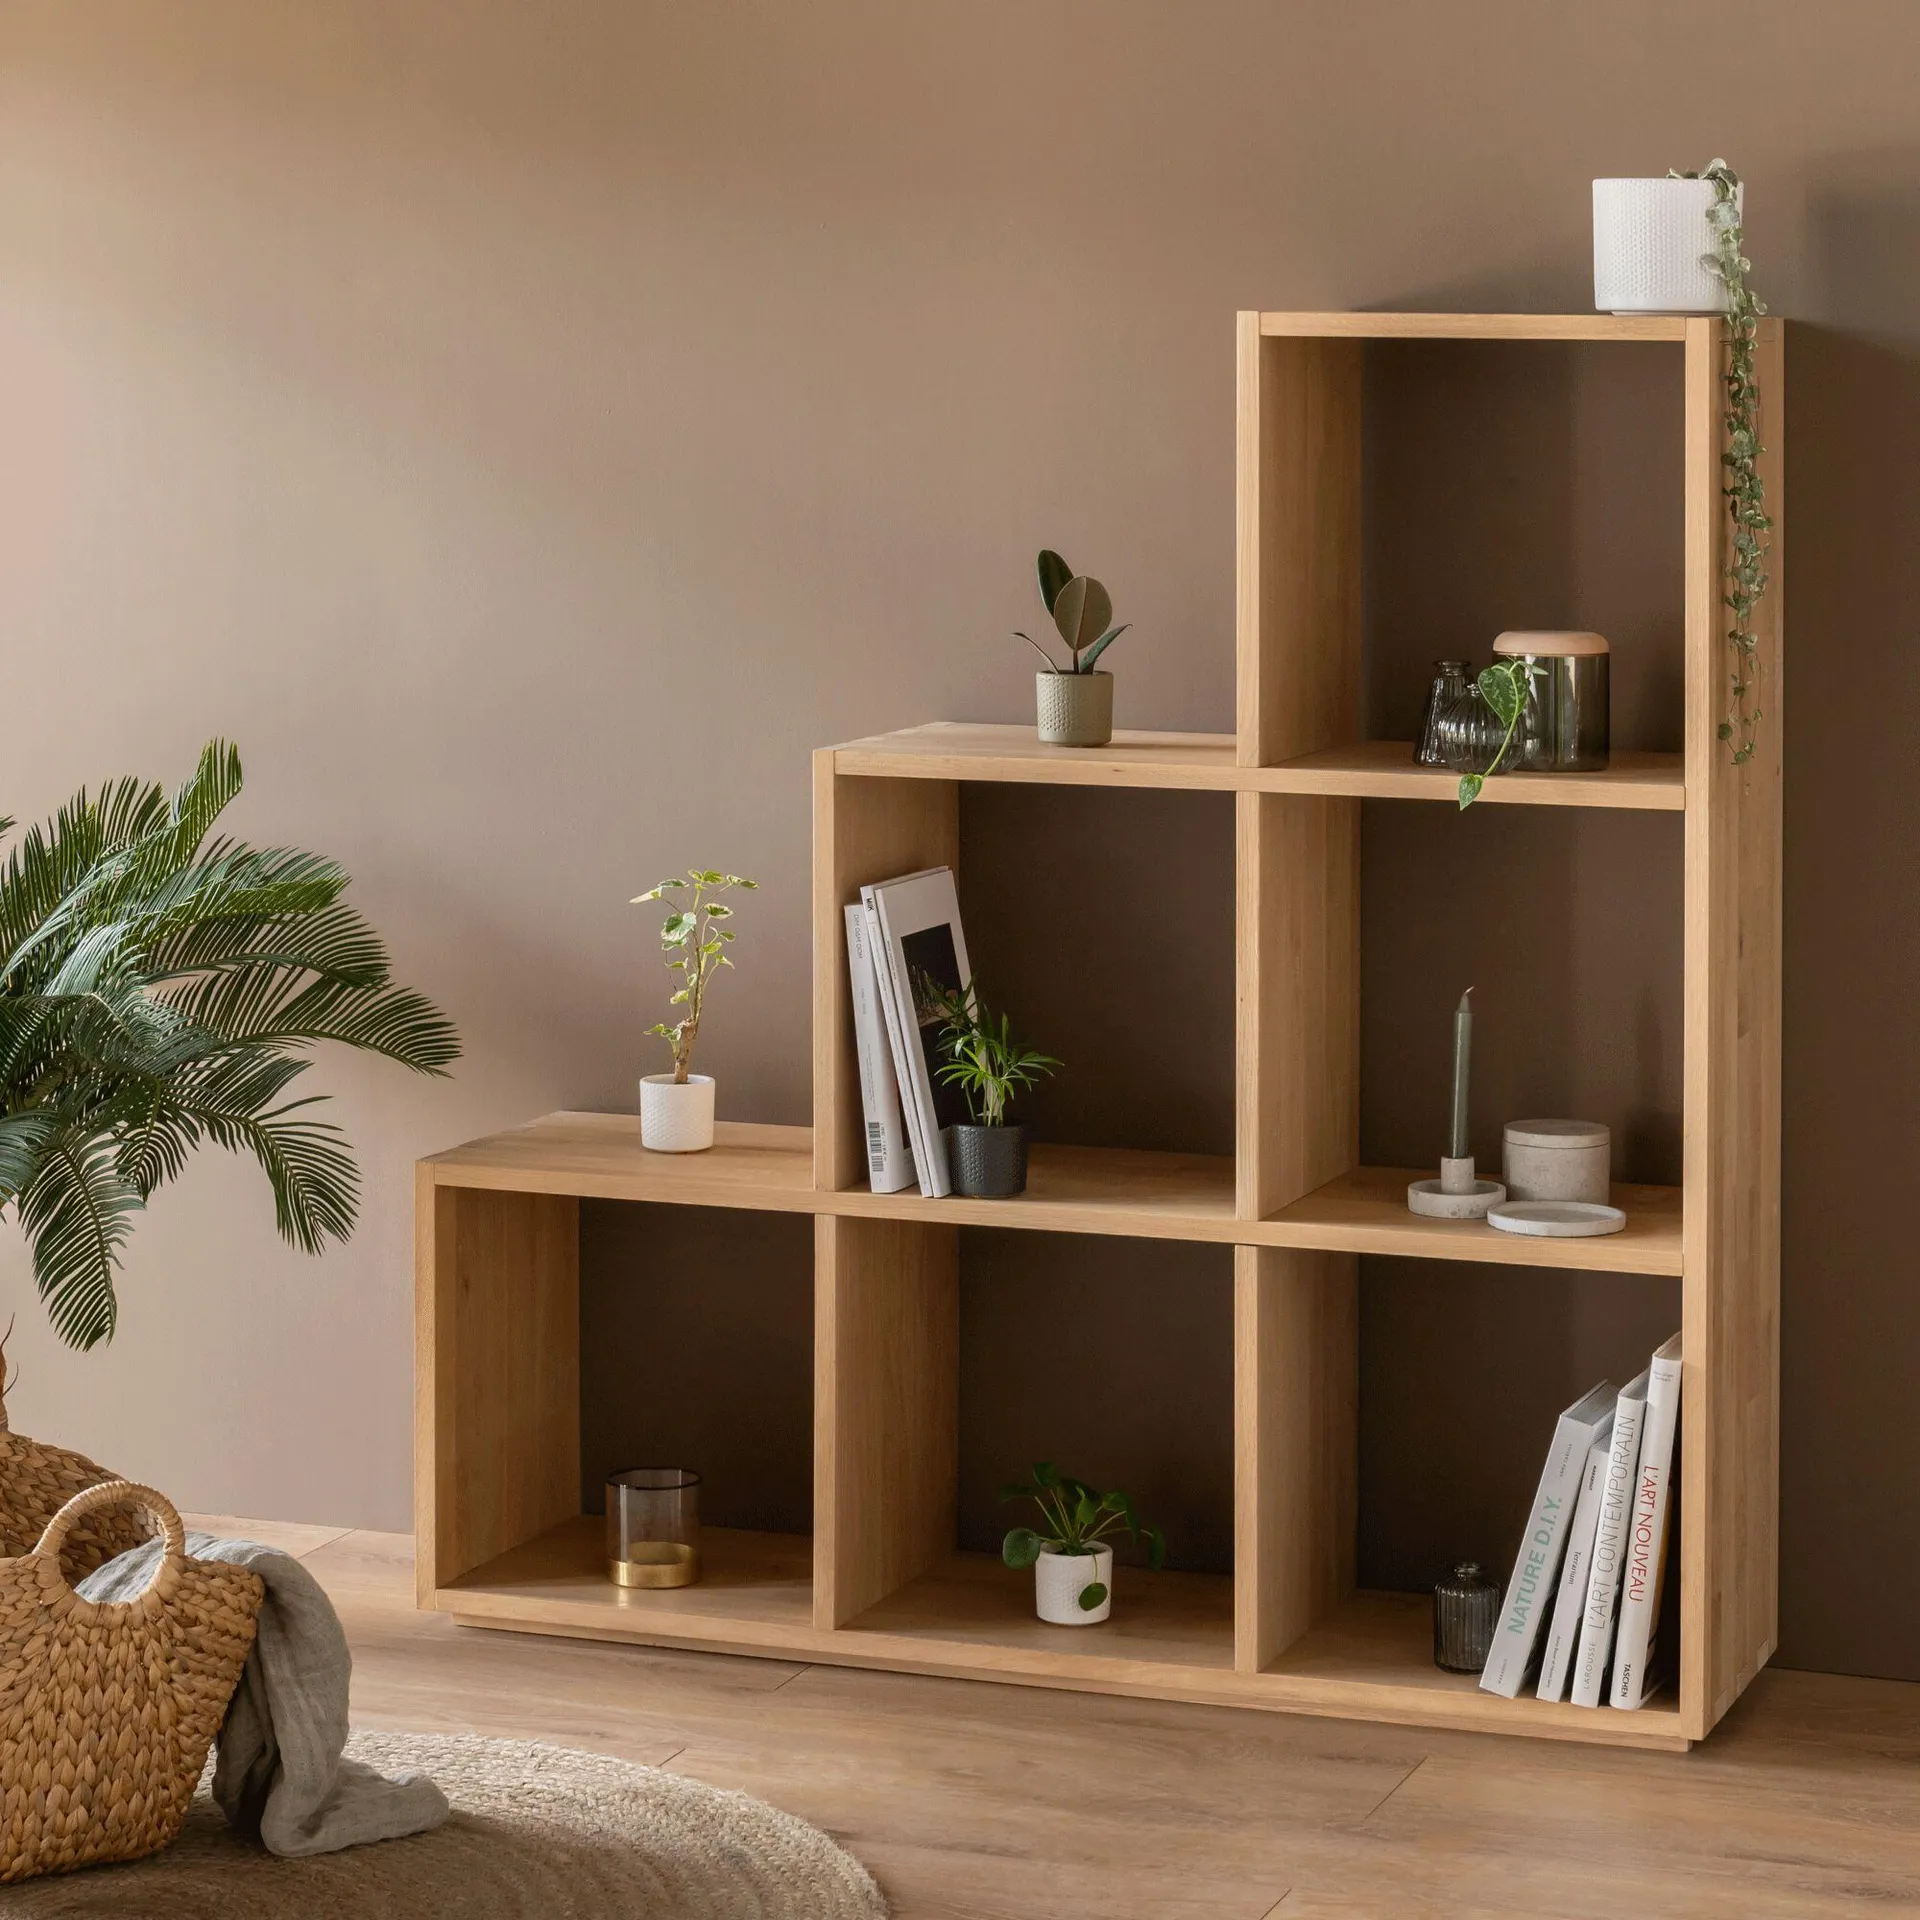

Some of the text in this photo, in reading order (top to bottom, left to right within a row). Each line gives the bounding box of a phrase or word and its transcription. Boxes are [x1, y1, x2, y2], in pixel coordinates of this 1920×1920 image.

[1507, 1495, 1562, 1635] NATURE D.I.Y.
[1567, 1551, 1581, 1585] Terrarium
[1589, 1416, 1635, 1630] L'ART CONTEMPORAIN
[1629, 1465, 1659, 1603] L'ART NOUVEAU
[1584, 1643, 1596, 1690] LAROUSSE
[1620, 1663, 1631, 1698] TASCHEN
